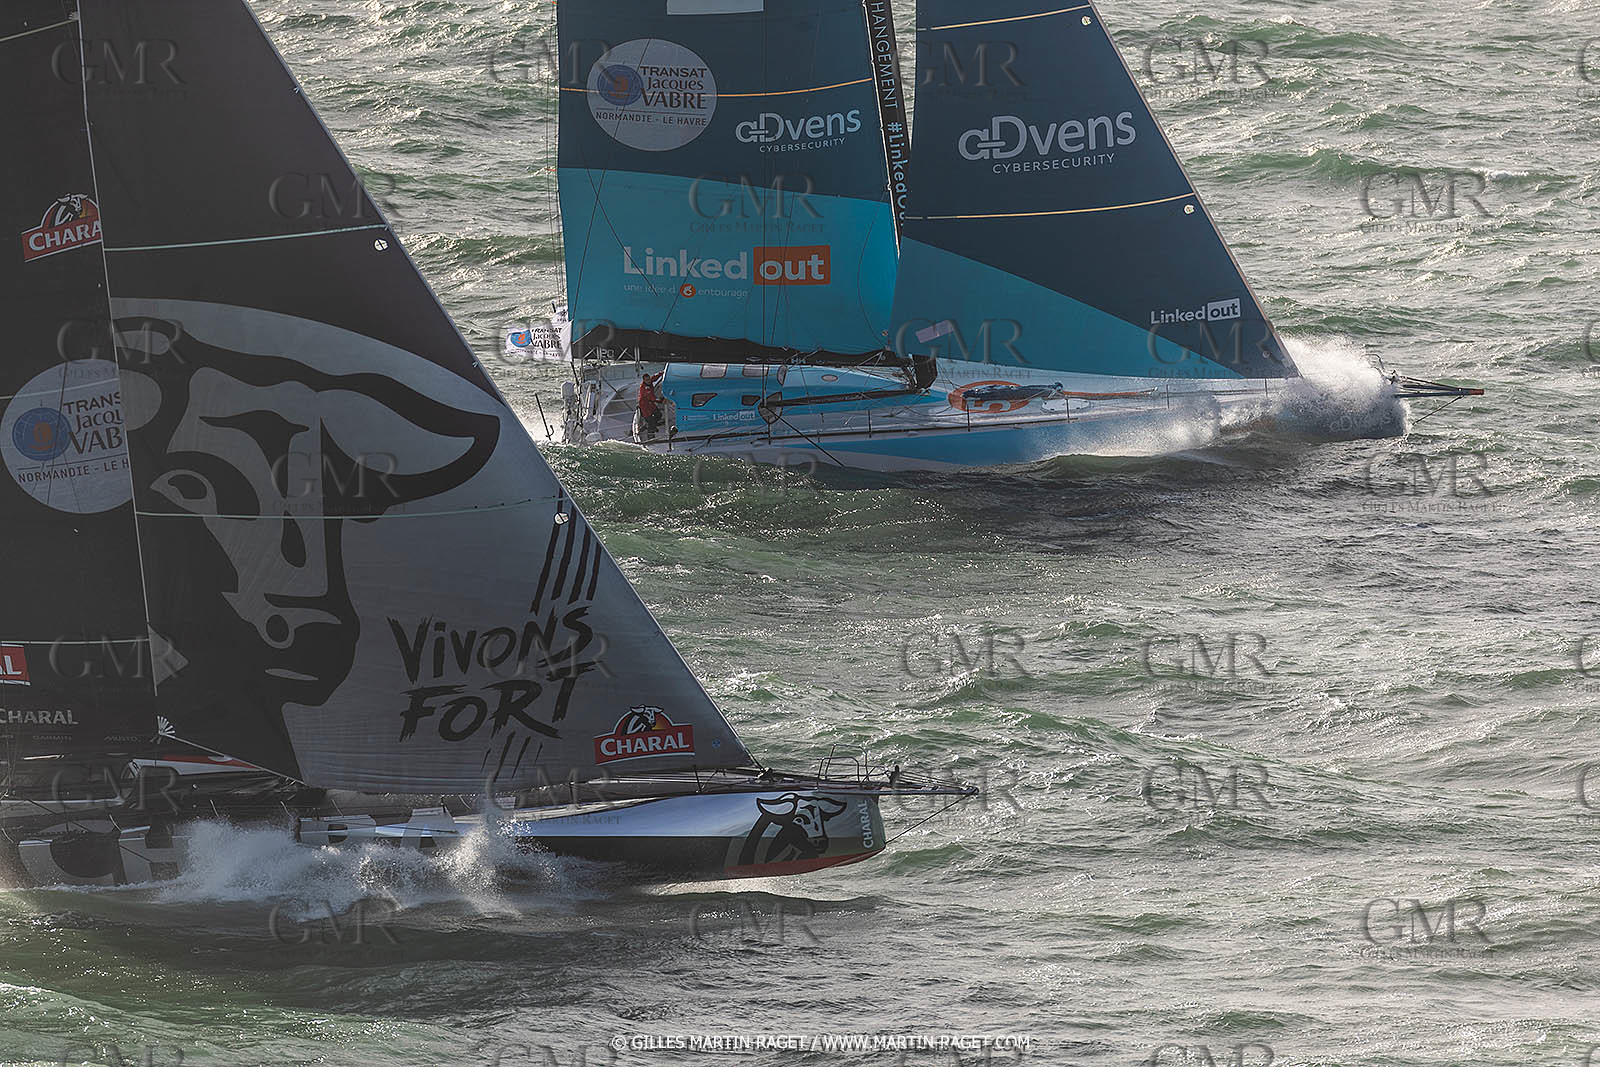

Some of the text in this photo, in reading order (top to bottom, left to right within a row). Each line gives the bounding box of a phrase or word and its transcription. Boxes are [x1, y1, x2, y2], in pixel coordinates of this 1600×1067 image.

[640, 66, 708, 78] TRANSAT
[641, 87, 708, 109] VABRE
[596, 111, 652, 123] NORMANDIE
[663, 116, 673, 124] LE
[677, 117, 707, 127] HAVRE
[760, 137, 846, 153] CYBERSECURITY
[887, 122, 908, 227] #LinkedO
[993, 153, 1115, 174] CYBERSECURITY
[698, 287, 748, 299] entourage
[18, 465, 90, 483] NORMANDIE
[104, 459, 118, 472] LE
[400, 661, 604, 742] FORT
[600, 732, 690, 756] CHARAL
[857, 800, 874, 849] CHARAL
